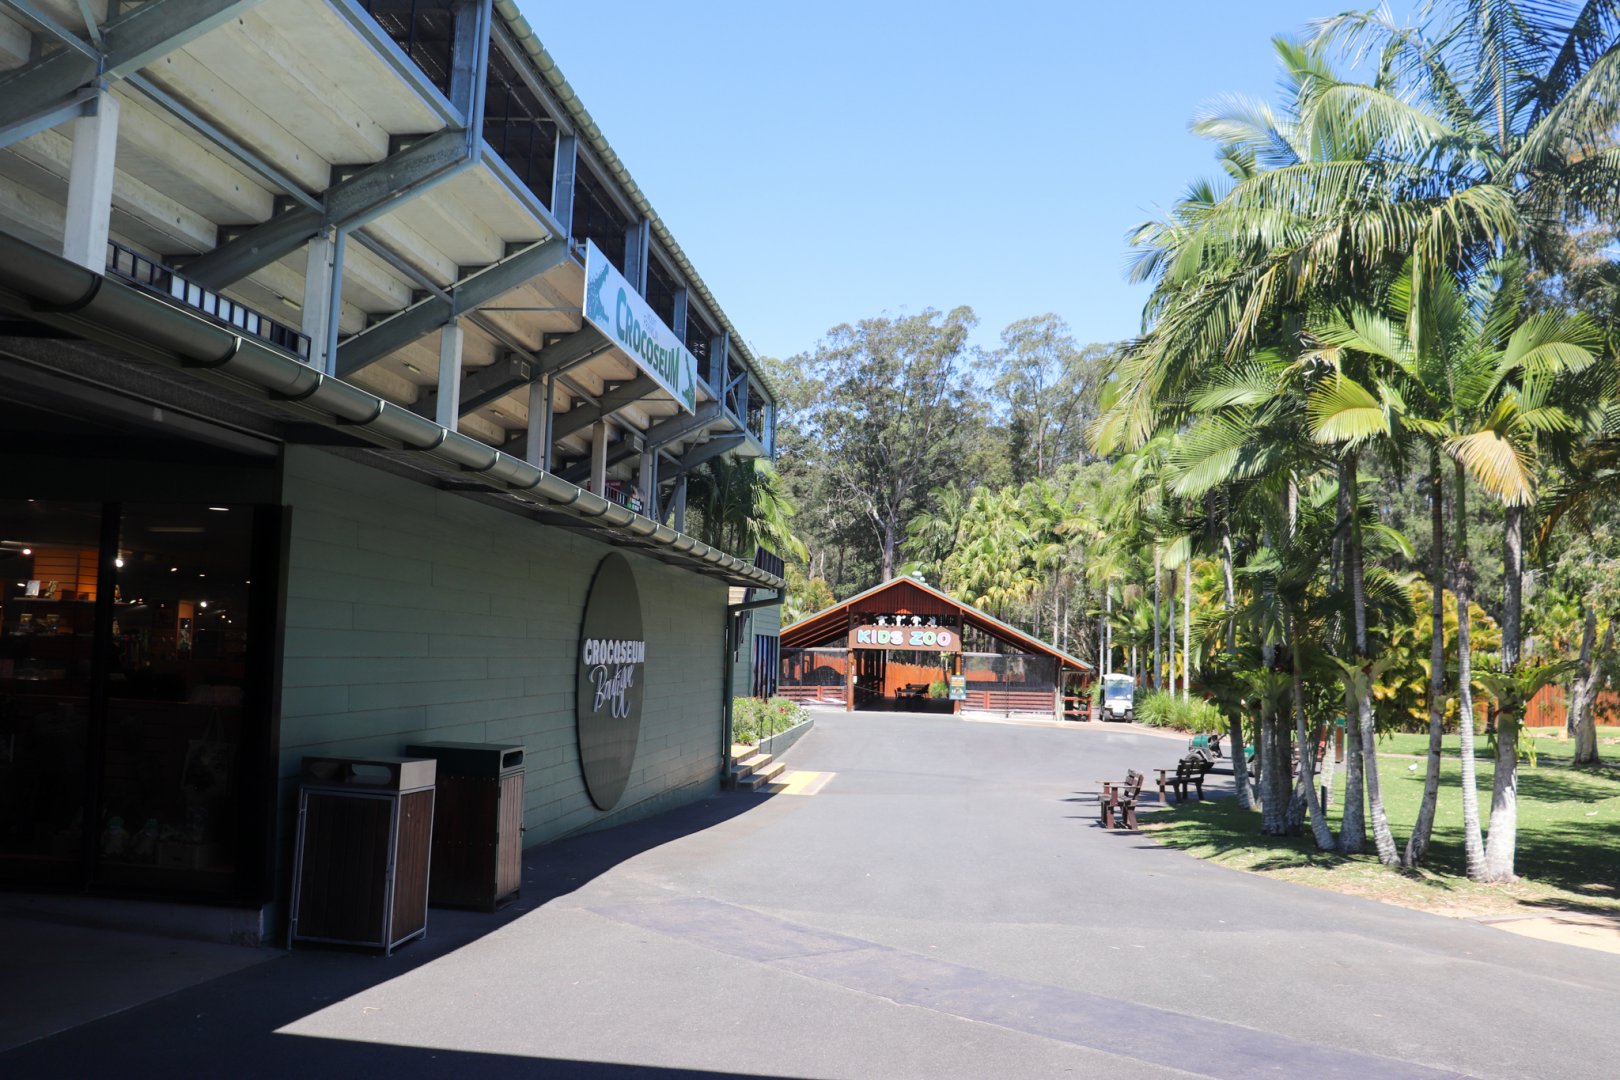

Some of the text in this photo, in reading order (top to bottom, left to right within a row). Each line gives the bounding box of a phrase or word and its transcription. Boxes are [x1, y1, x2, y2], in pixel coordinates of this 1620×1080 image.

[616, 287, 680, 393] CROCOSEUM
[583, 638, 645, 665] CROCOSEUM
[857, 629, 952, 647] KIDS ZOO
